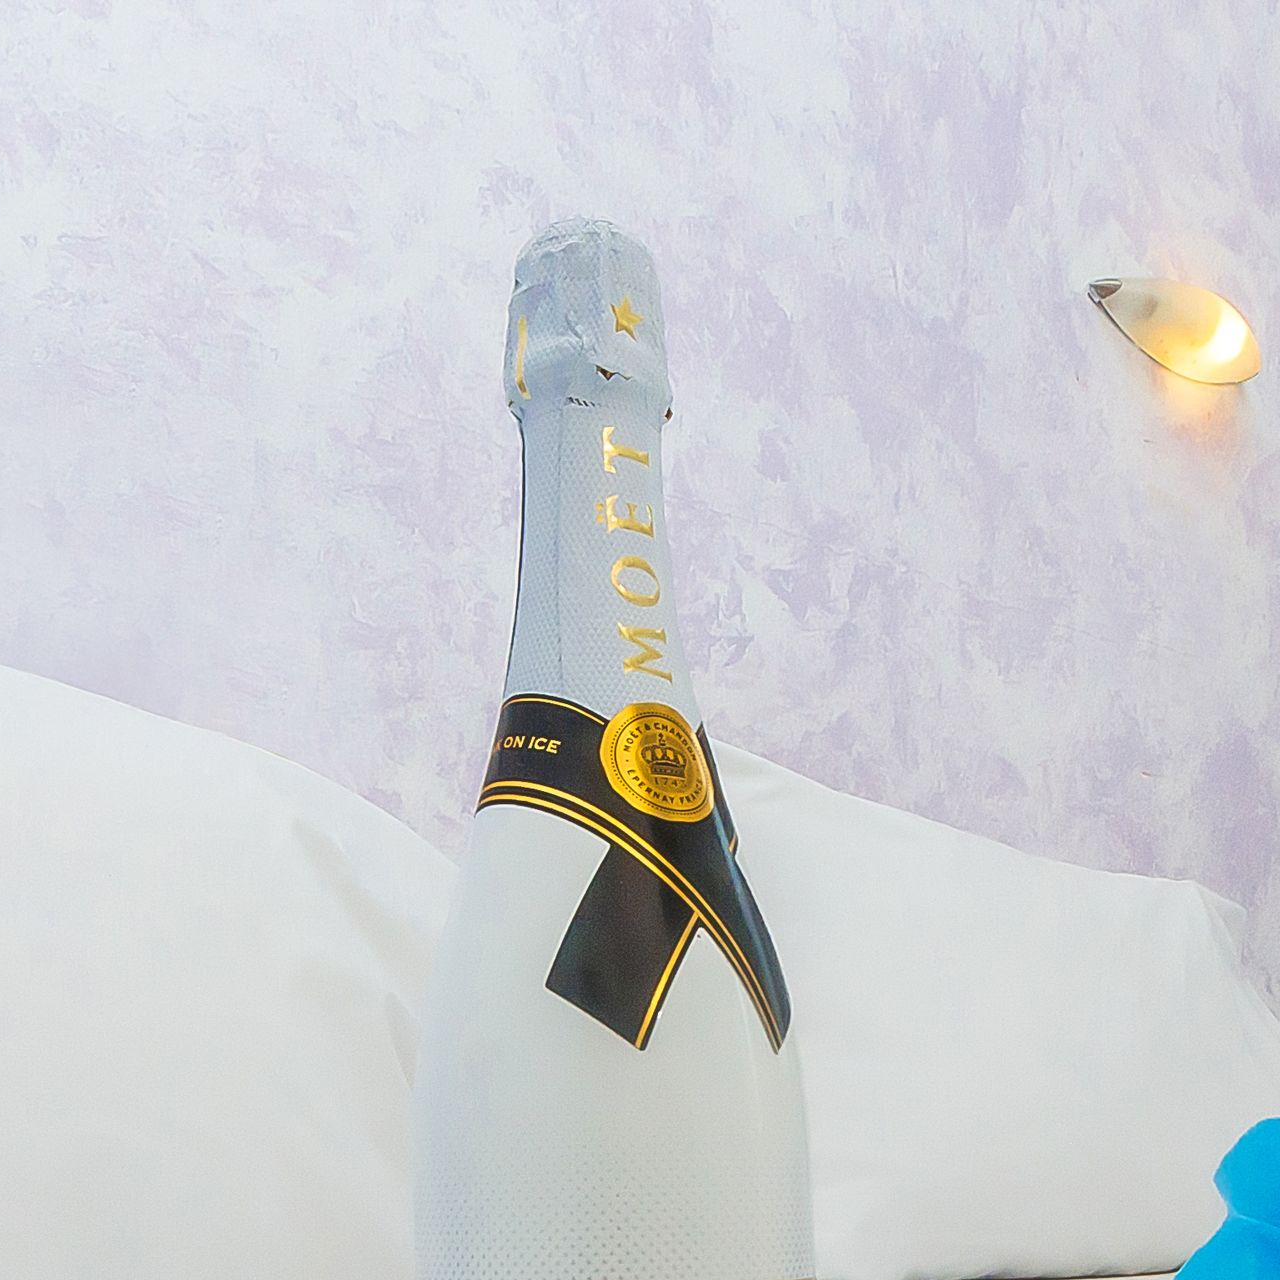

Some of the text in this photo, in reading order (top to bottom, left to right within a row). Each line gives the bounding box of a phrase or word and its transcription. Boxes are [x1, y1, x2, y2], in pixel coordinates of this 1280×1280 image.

[595, 426, 673, 685] MOËT
[503, 735, 526, 749] ON
[527, 735, 562, 754] ICE
